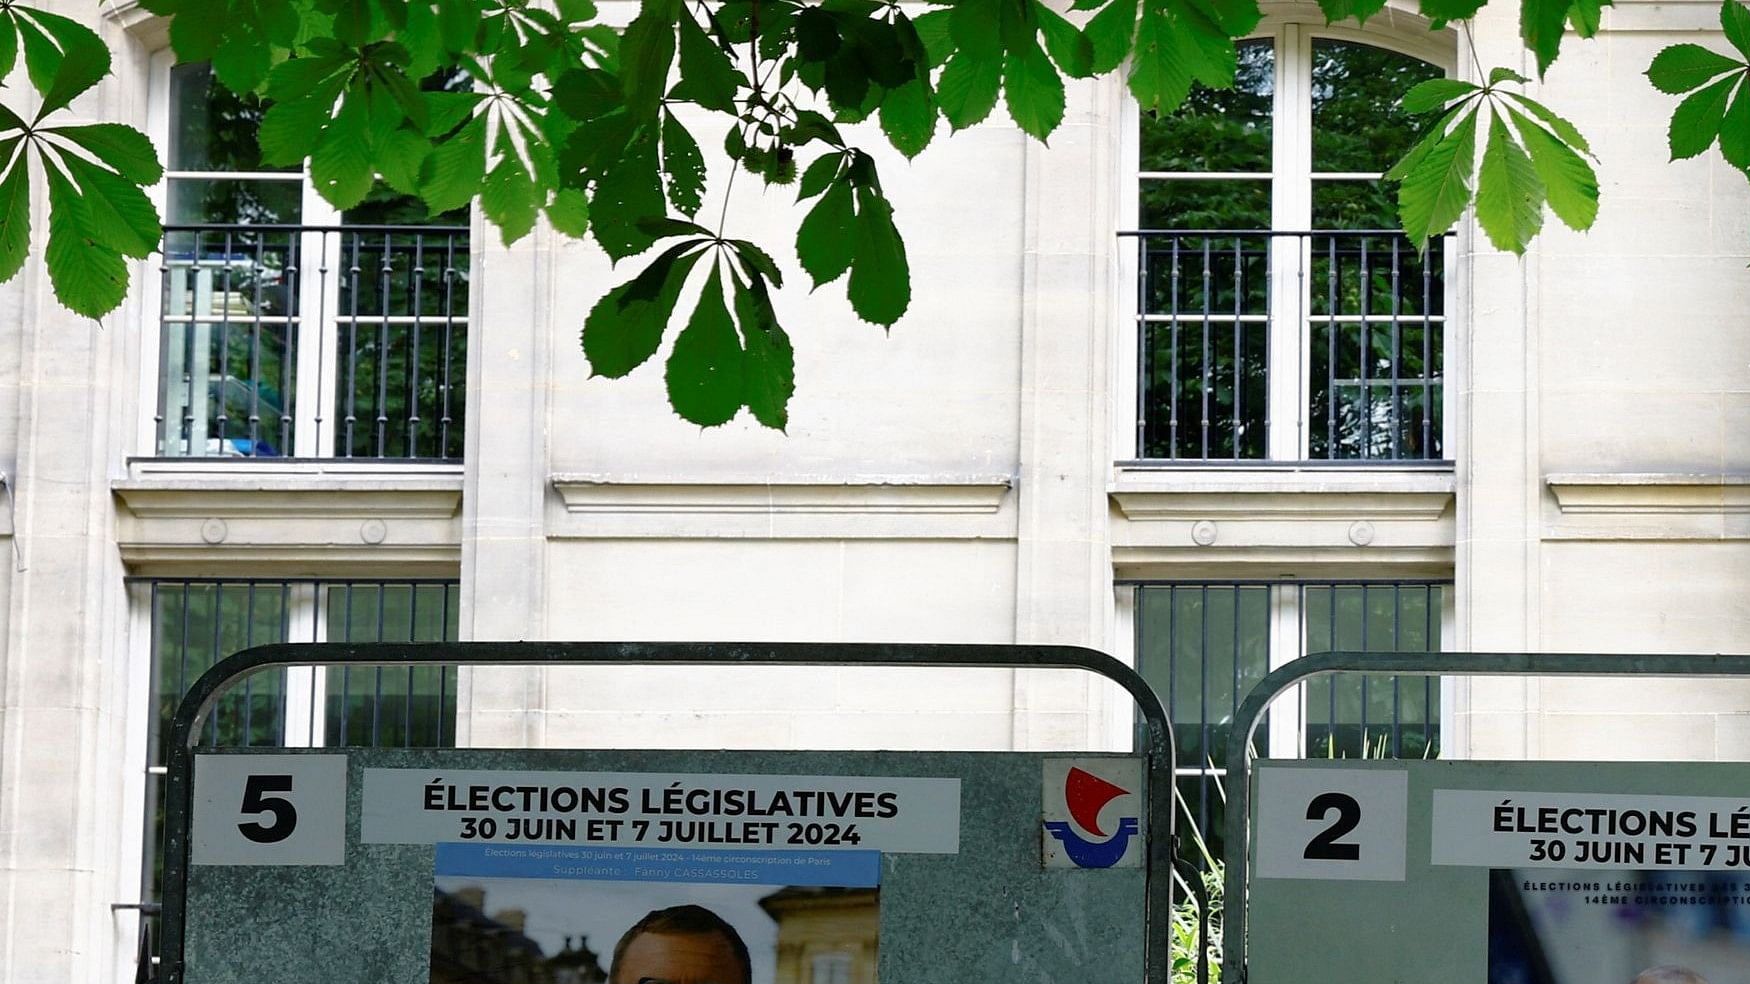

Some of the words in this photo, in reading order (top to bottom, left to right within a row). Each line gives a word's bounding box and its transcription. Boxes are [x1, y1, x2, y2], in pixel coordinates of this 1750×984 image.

[237, 775, 297, 843] 5
[424, 778, 629, 813] ÉLECTIONS
[641, 782, 899, 819] LÉGISLATIVES
[460, 818, 497, 839] 30
[505, 818, 577, 841] JUIN
[587, 820, 624, 841] ET
[632, 820, 650, 842] 7
[657, 821, 779, 844] JUILLET
[787, 823, 862, 845] 2024
[1303, 792, 1361, 860] 2
[1493, 800, 1697, 837] ÉLECTIONS
[484, 847, 526, 857] Élections
[528, 849, 580, 860] législatives
[581, 851, 593, 859] 30
[594, 851, 612, 862] juin
[614, 852, 623, 860] et
[626, 852, 632, 860] 7
[633, 852, 658, 862] juillet
[662, 853, 684, 861] 2024
[725, 855, 792, 866] circonscription
[793, 856, 806, 865] de
[808, 857, 832, 866] Paris
[1529, 839, 1566, 862] 30
[1574, 841, 1644, 864] JUIN
[1655, 843, 1692, 865] ET
[1700, 844, 1717, 866] 7
[553, 865, 621, 876] Suppléante
[635, 867, 670, 878] Fanny
[674, 868, 759, 880] CASSASSOLES
[1523, 880, 1601, 892] ÉLECTIONS
[1607, 881, 1705, 893] LÉGISLATIVES
